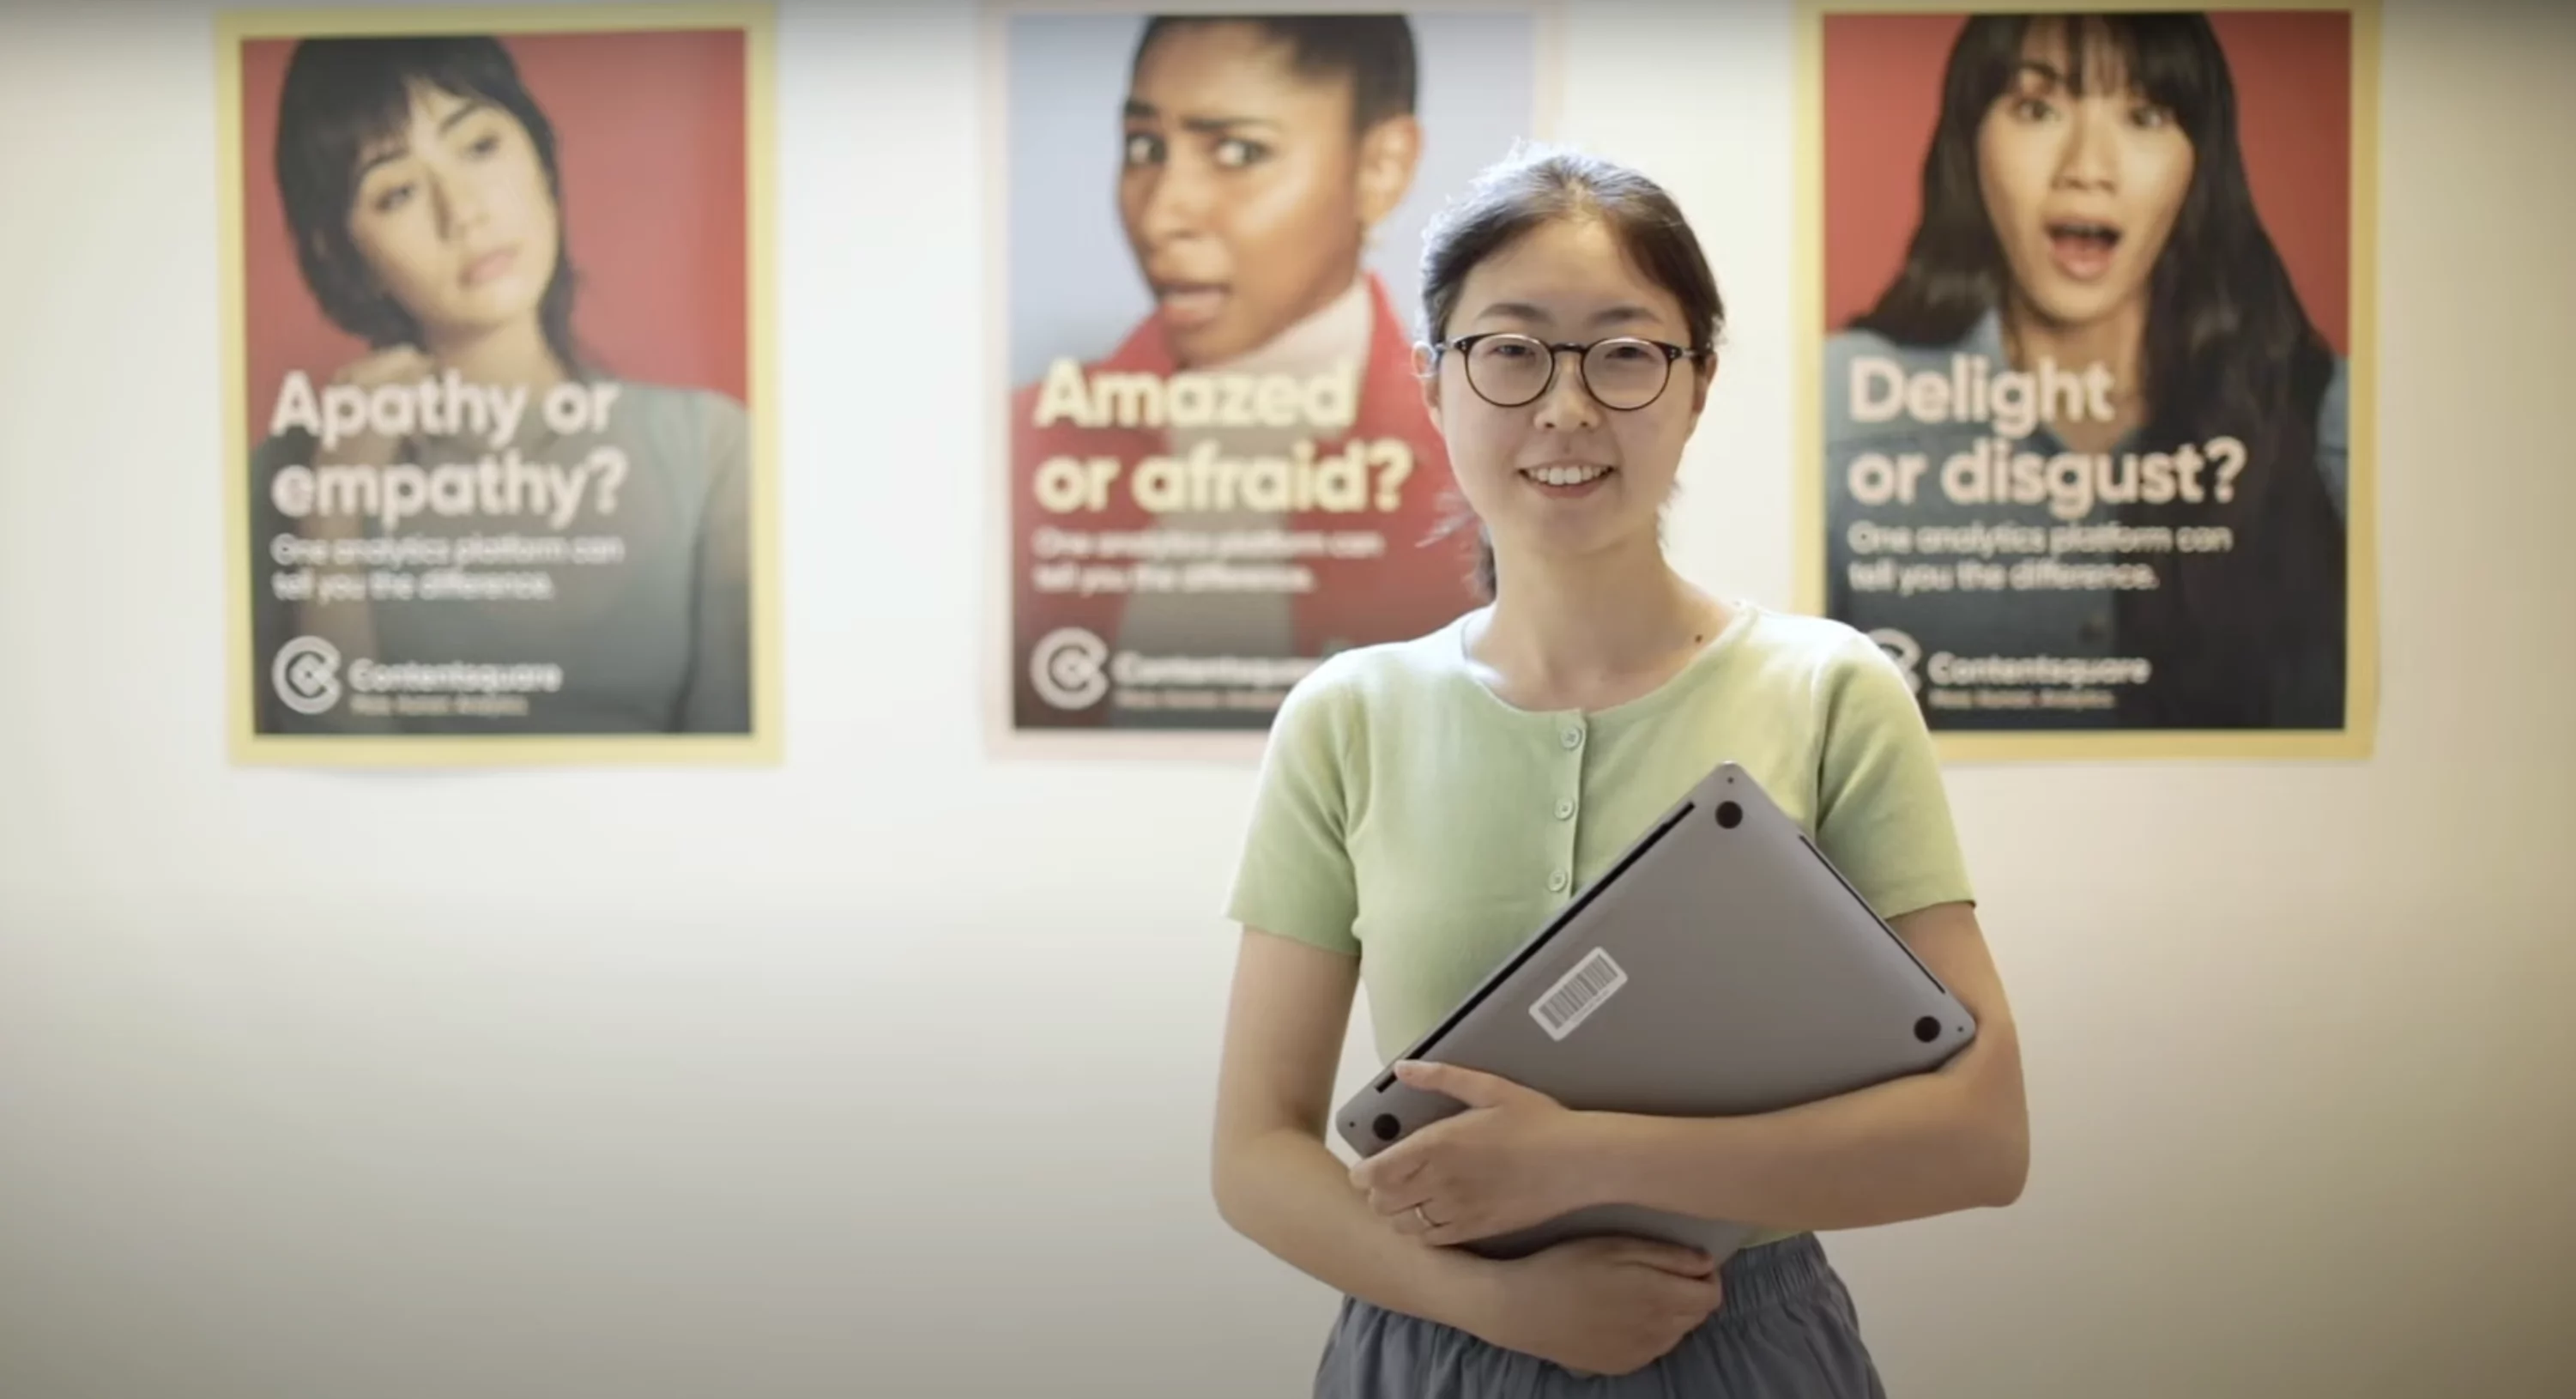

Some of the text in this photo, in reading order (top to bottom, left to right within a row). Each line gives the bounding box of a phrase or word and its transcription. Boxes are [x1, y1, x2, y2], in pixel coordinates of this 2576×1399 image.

[270, 369, 621, 451] Apathy or
[1034, 357, 1358, 428] Amazed
[1847, 354, 2117, 439] Delight
[271, 447, 628, 528] empathy?
[1033, 438, 1414, 512] or afraid?
[1847, 436, 2247, 520] or disgust?
[269, 533, 329, 566] One
[1847, 519, 2234, 560] One analytics platform can
[1847, 558, 2162, 598] tell you the difference.
[1927, 651, 2152, 689] Contentsquare
